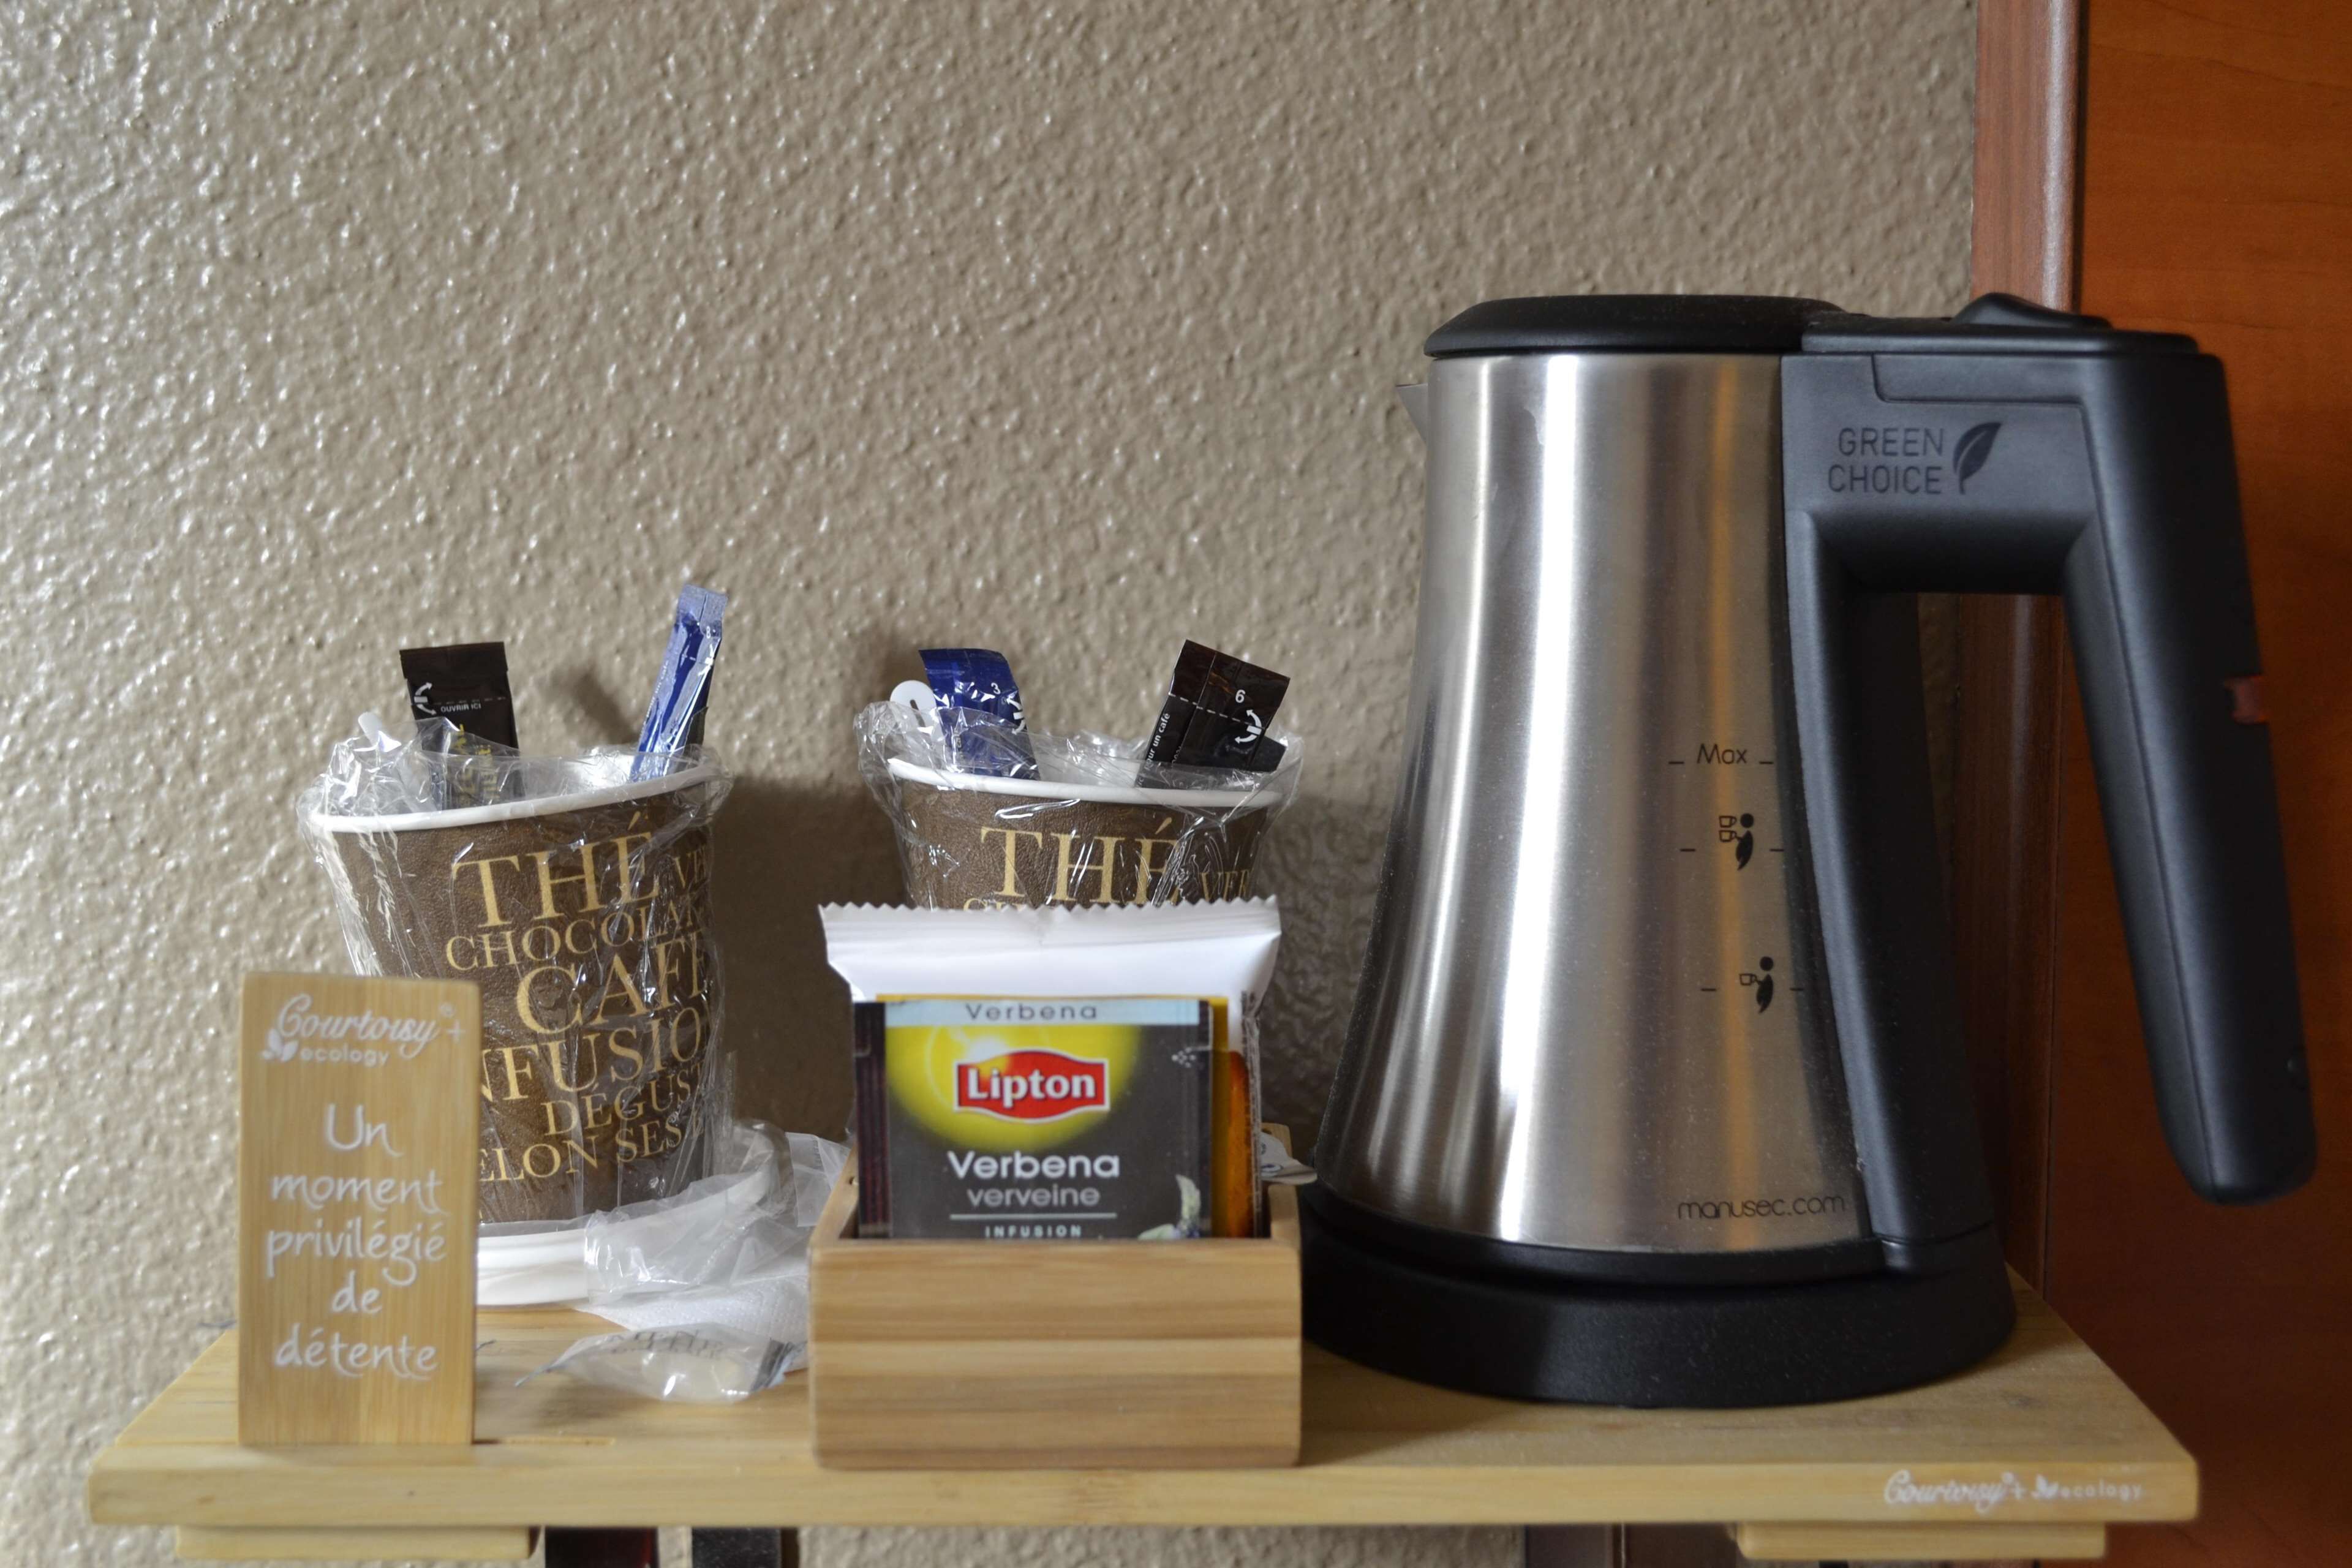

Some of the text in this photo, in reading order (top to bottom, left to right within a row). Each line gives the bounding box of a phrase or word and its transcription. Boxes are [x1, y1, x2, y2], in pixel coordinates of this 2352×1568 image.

[1838, 427, 1944, 457] GREEN
[1828, 464, 1943, 495] CHOICE
[990, 682, 1001, 695] 3
[1235, 689, 1246, 703] 6
[440, 704, 470, 713] OUVRIR
[1153, 735, 1161, 747] un
[1158, 713, 1170, 733] café
[1696, 743, 1747, 765] Max
[964, 1003, 1098, 1021] Verbena
[300, 1042, 390, 1068] ecology
[967, 1067, 1096, 1109] Lipton
[324, 1103, 404, 1158] Un
[946, 1149, 1120, 1180] Verbena
[270, 1168, 452, 1215] moment
[966, 1183, 1101, 1207] verveine
[1677, 1194, 1846, 1220] manusec.com
[984, 1224, 1082, 1238] INFUSION
[265, 1215, 447, 1287] privilégié
[329, 1268, 383, 1315] de
[273, 1321, 440, 1381] détente
[2060, 1479, 2143, 1502] ecology
